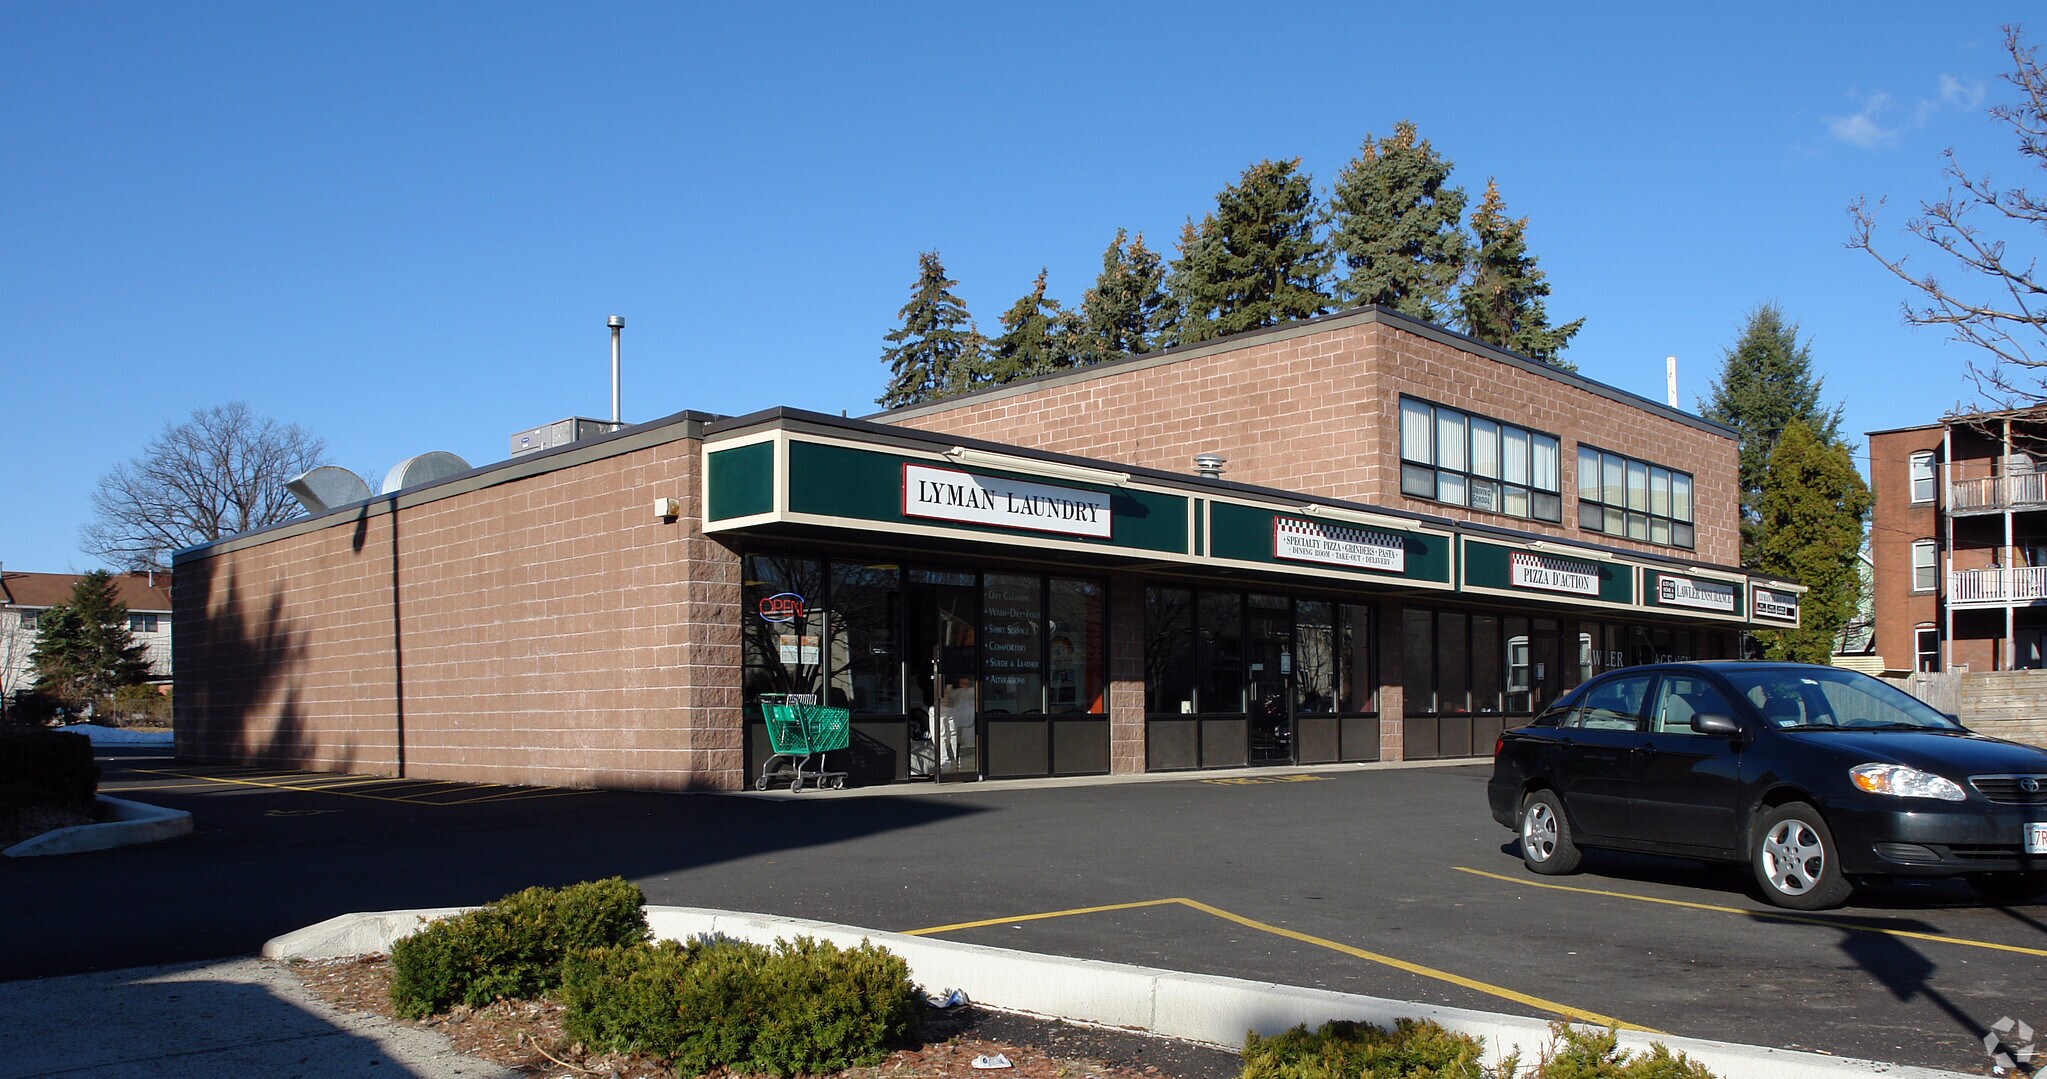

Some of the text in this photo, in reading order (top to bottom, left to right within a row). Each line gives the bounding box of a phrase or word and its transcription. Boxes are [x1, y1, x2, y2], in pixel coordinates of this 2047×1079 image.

[1472, 486, 1491, 497] DRIVING
[918, 480, 1100, 523] LYMAN LAUNDRY
[1472, 494, 1490, 505] SCHOOL
[1286, 536, 1396, 559] SPECIALTY PIZZA GRINDERS PASTA
[1292, 547, 1391, 566] DINING ROOM TAKE-OUT DELIVERY
[1523, 568, 1590, 590] PIZZA D'ACTION
[760, 598, 803, 617] OPEN
[989, 641, 1027, 652] COMFORTERS
[989, 658, 1008, 668] SUEDE
[990, 674, 1026, 685] ALTERATIONS
